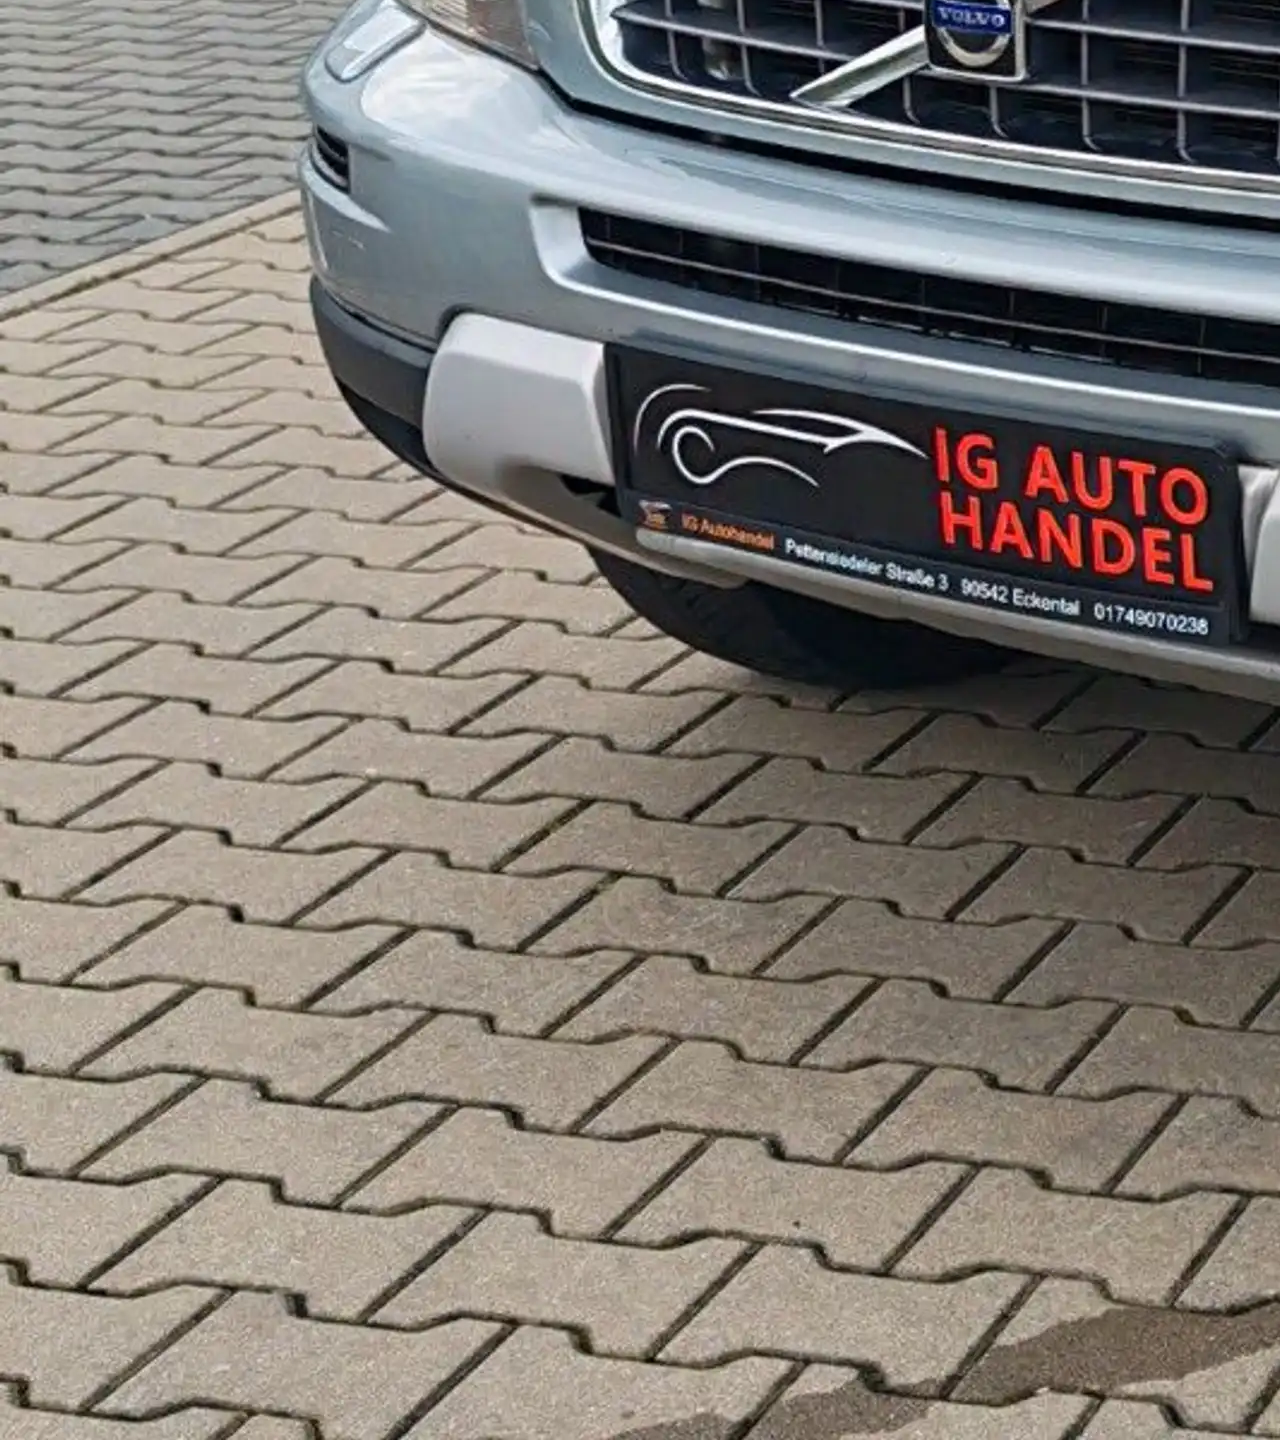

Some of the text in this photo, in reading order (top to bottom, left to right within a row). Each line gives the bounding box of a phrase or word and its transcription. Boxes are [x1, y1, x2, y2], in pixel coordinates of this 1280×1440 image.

[937, 6, 1006, 28] VOLVO
[934, 426, 1209, 526] IG AUTO
[940, 490, 1214, 592] HANDEL
[885, 561, 936, 589] Straße
[938, 573, 950, 592] 3
[960, 578, 1009, 604] 90542
[1012, 587, 1080, 616] Eckental
